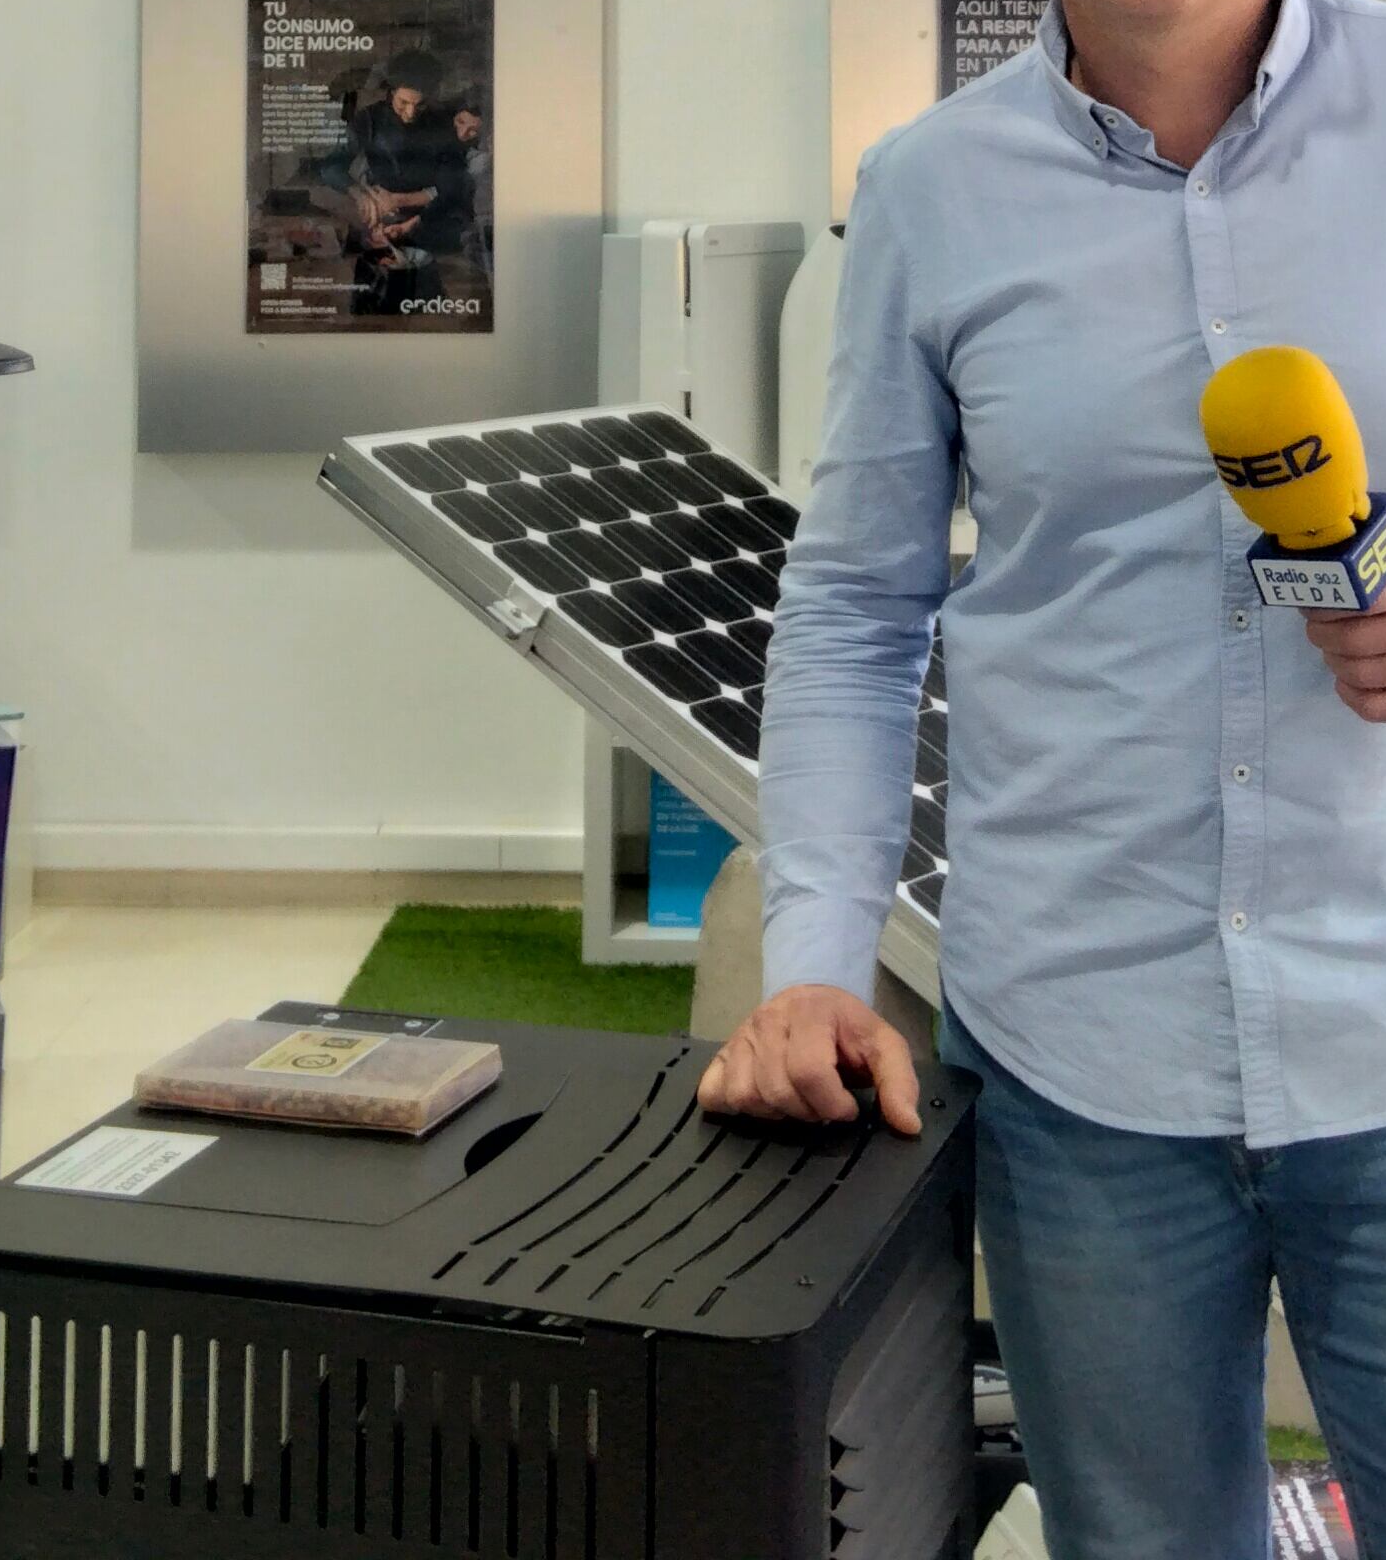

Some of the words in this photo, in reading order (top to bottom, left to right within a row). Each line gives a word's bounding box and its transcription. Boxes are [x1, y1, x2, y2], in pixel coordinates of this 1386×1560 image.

[263, 1, 286, 16] TU
[263, 18, 355, 34] CONSUMO
[956, 20, 979, 34] LA
[263, 36, 304, 51] DICE
[307, 35, 374, 51] MUCHO
[956, 38, 1003, 54] PARA
[263, 53, 286, 68] DE
[289, 53, 305, 68] TI
[956, 58, 979, 73] EN
[399, 295, 480, 315] endesa
[1262, 566, 1309, 585] Radio
[1314, 573, 1341, 586] 90.2
[1273, 586, 1345, 604] ELDA
